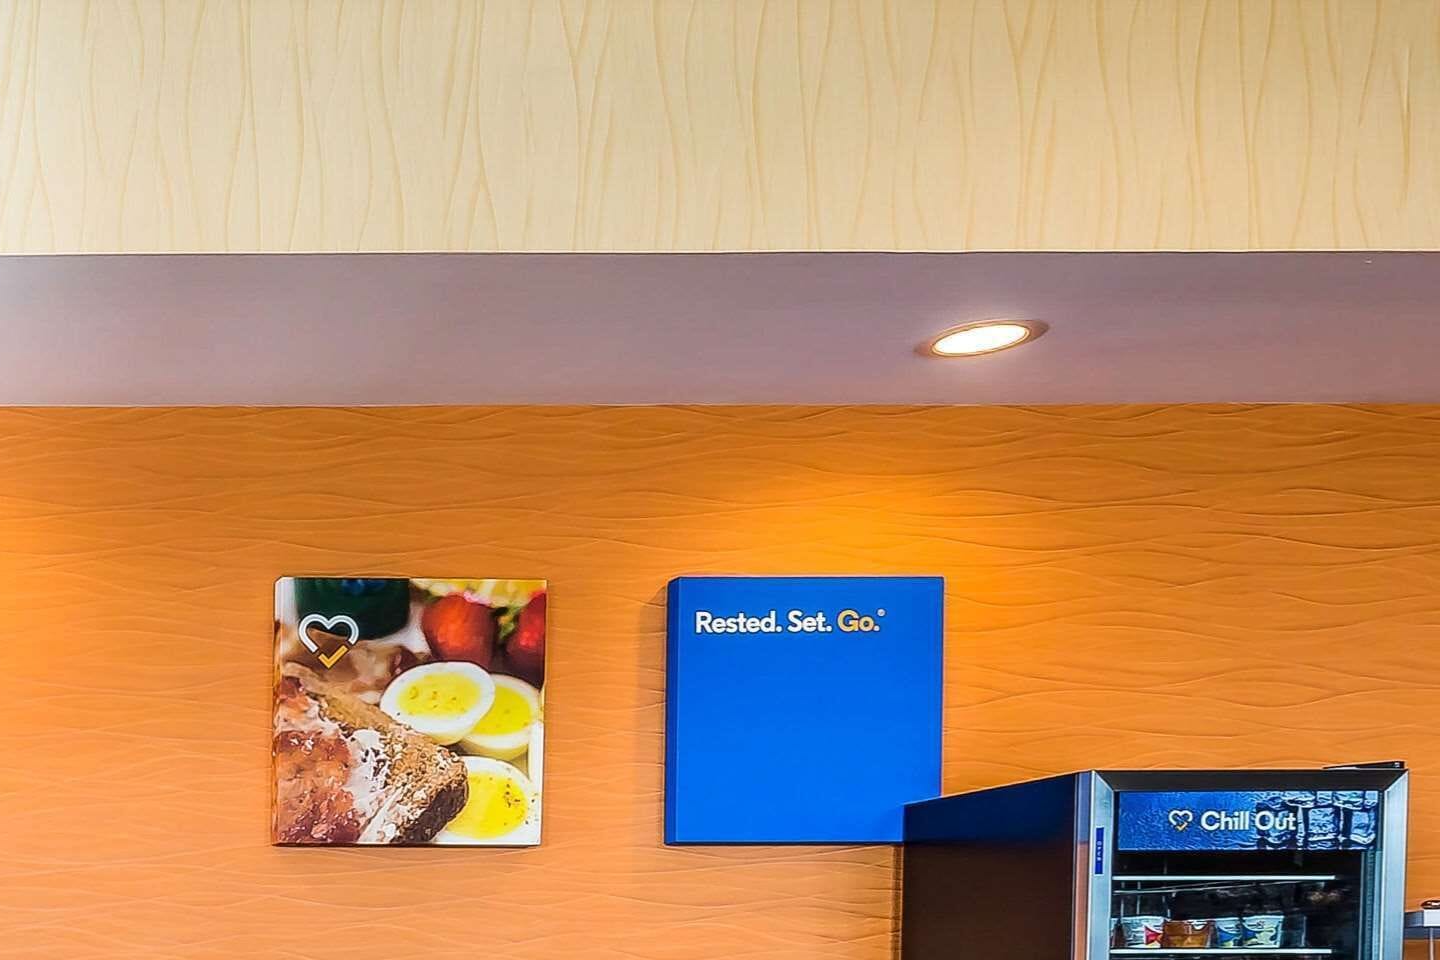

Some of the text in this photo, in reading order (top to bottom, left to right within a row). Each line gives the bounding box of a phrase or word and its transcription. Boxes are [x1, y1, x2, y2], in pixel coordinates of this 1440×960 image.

[695, 611, 783, 633] Rested.
[787, 610, 833, 632] Set.
[1200, 810, 1297, 831] Chill Out
